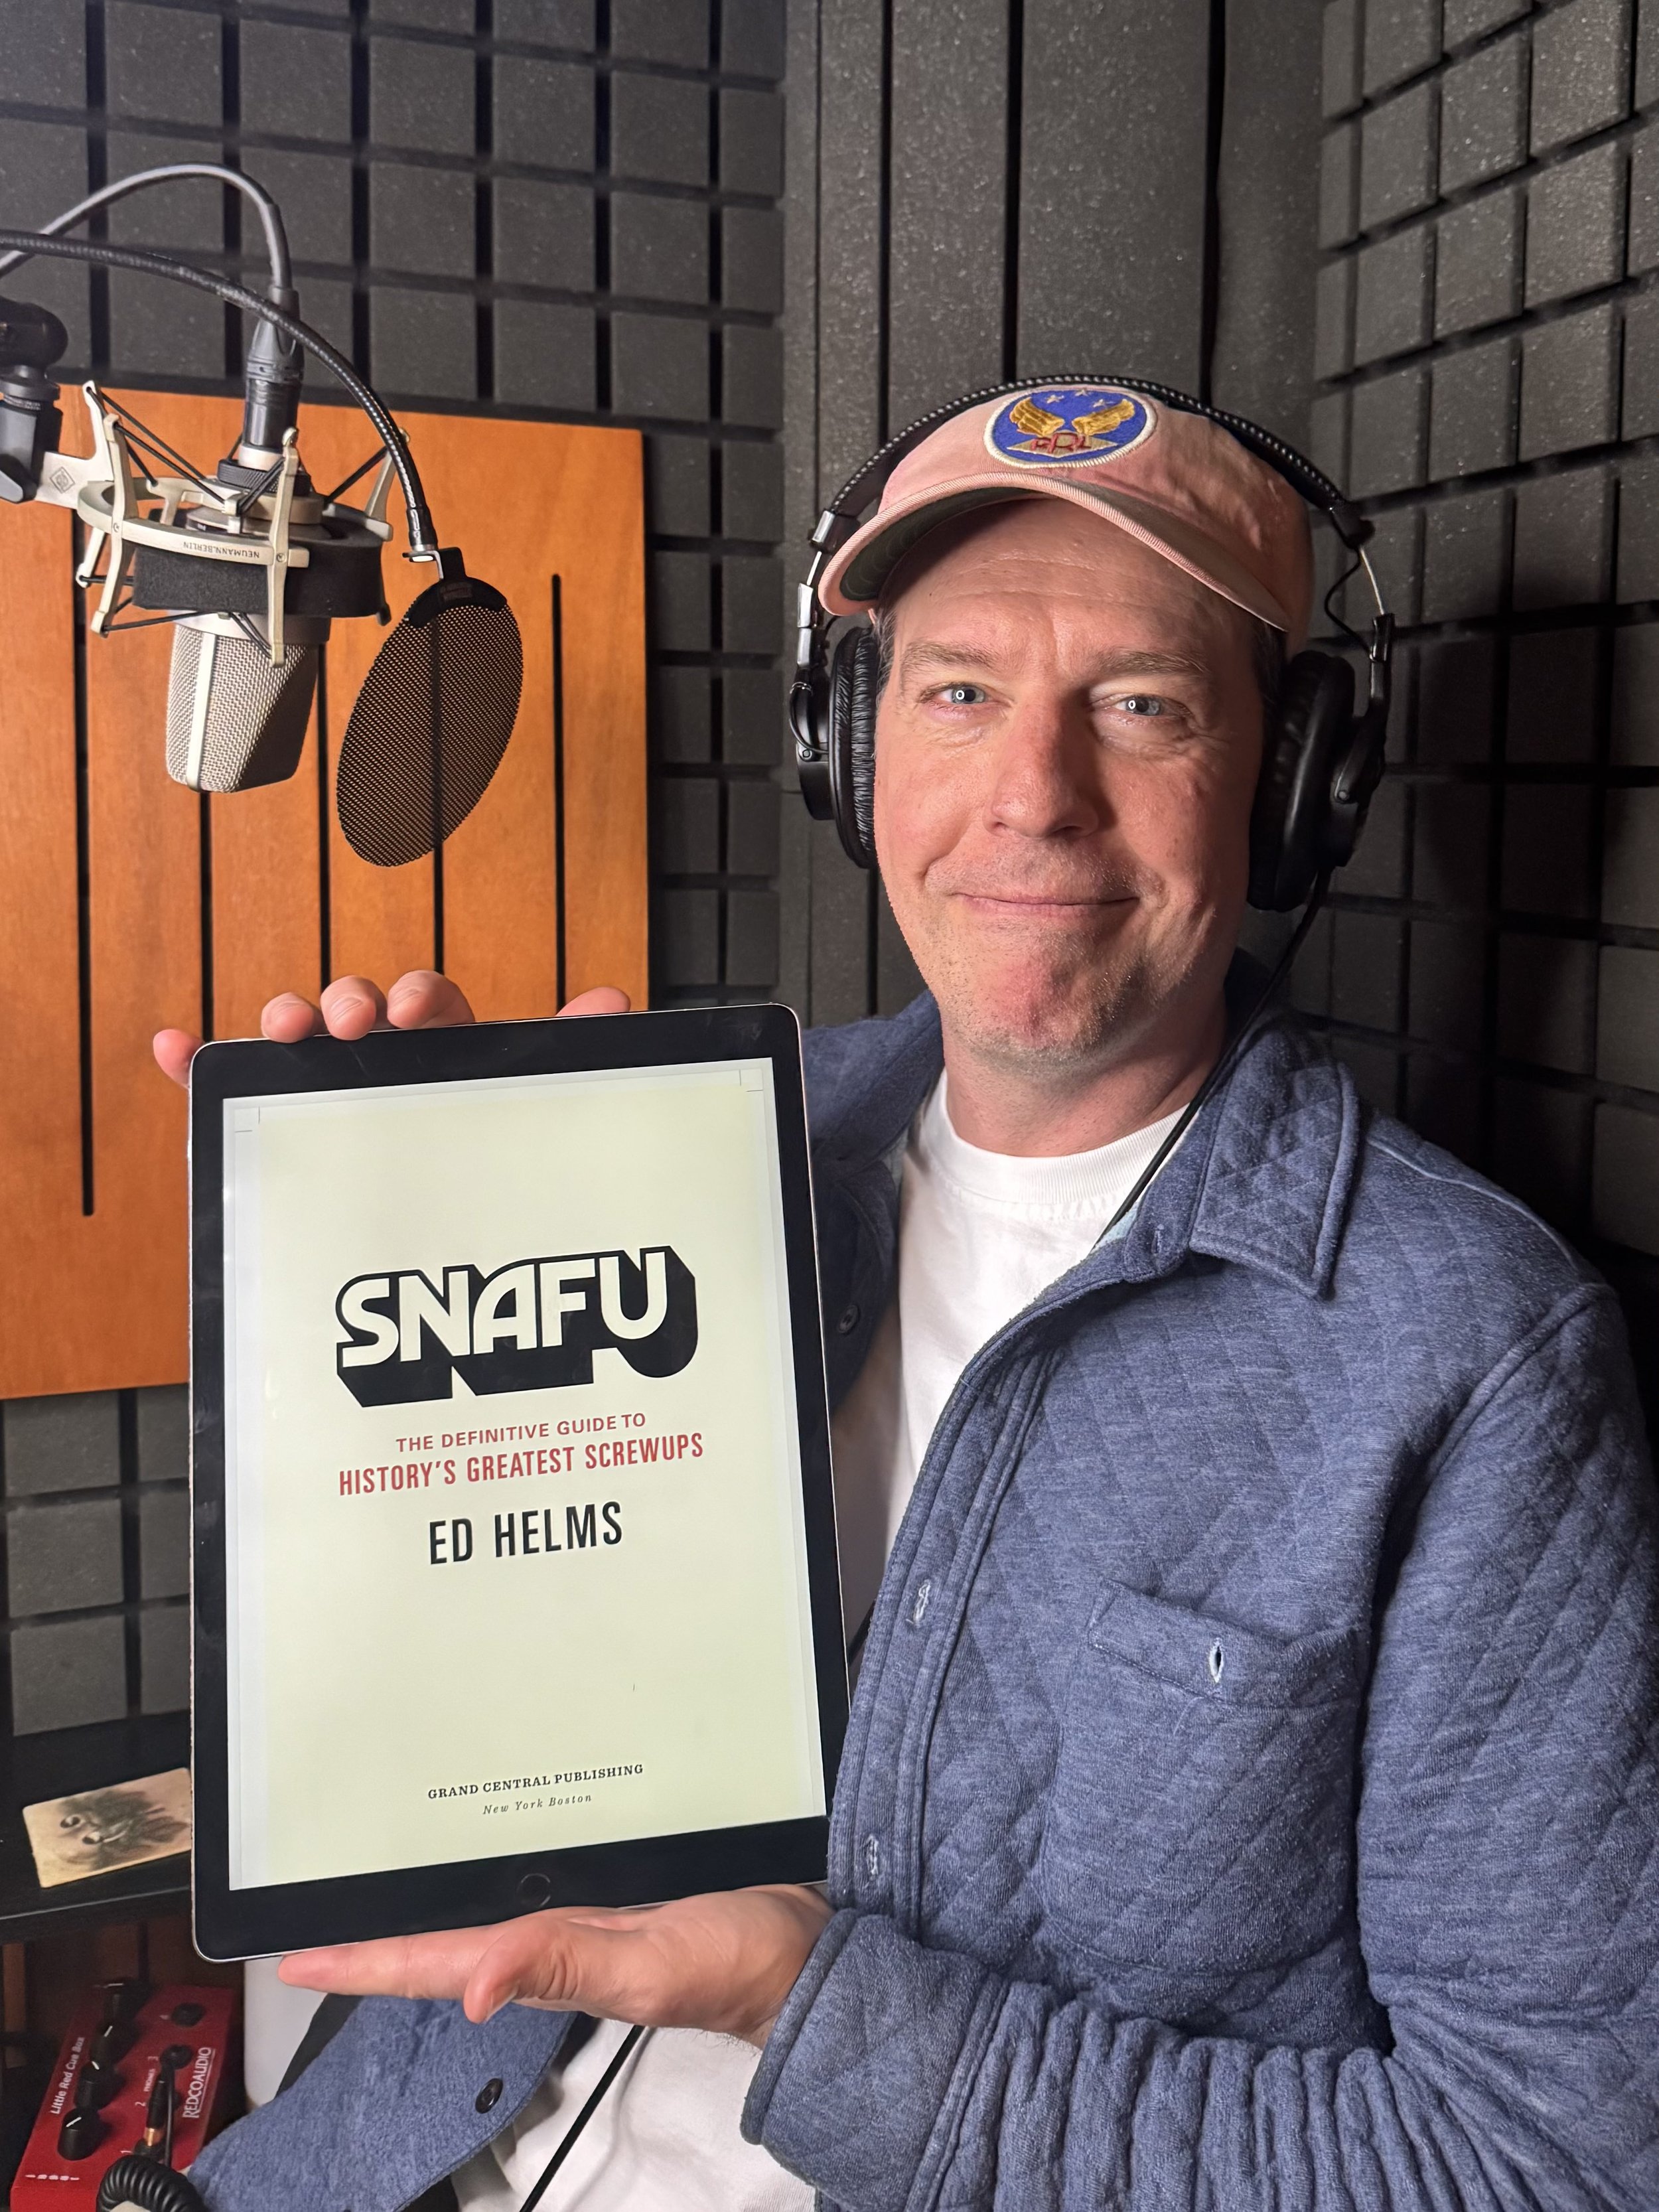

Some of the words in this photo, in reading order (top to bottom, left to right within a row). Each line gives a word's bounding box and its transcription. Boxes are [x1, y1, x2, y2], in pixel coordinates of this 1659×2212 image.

[335, 1245, 699, 1408] SNAFU
[396, 1436, 433, 1452] THE
[442, 1423, 549, 1449] DEFINITIVE
[557, 1416, 616, 1435] GUIDE
[621, 1413, 645, 1428] TO
[340, 1460, 455, 1495] HISTORY'S
[467, 1447, 574, 1482] GREATEST
[585, 1433, 703, 1469] SCREWUPS
[430, 1518, 472, 1564] ED
[494, 1501, 622, 1558] HELMS
[428, 1785, 478, 1799] GRAND
[483, 1776, 550, 1792] CENTRAL
[555, 1764, 644, 1784] PUBLISHING
[483, 1805, 508, 1814] New
[516, 1799, 542, 1810] York
[549, 1795, 591, 1806] Boston
[58, 2071, 74, 2089] Red
[182, 2047, 212, 2118] REDCOAUDIO
[50, 2091, 67, 2114] Little
